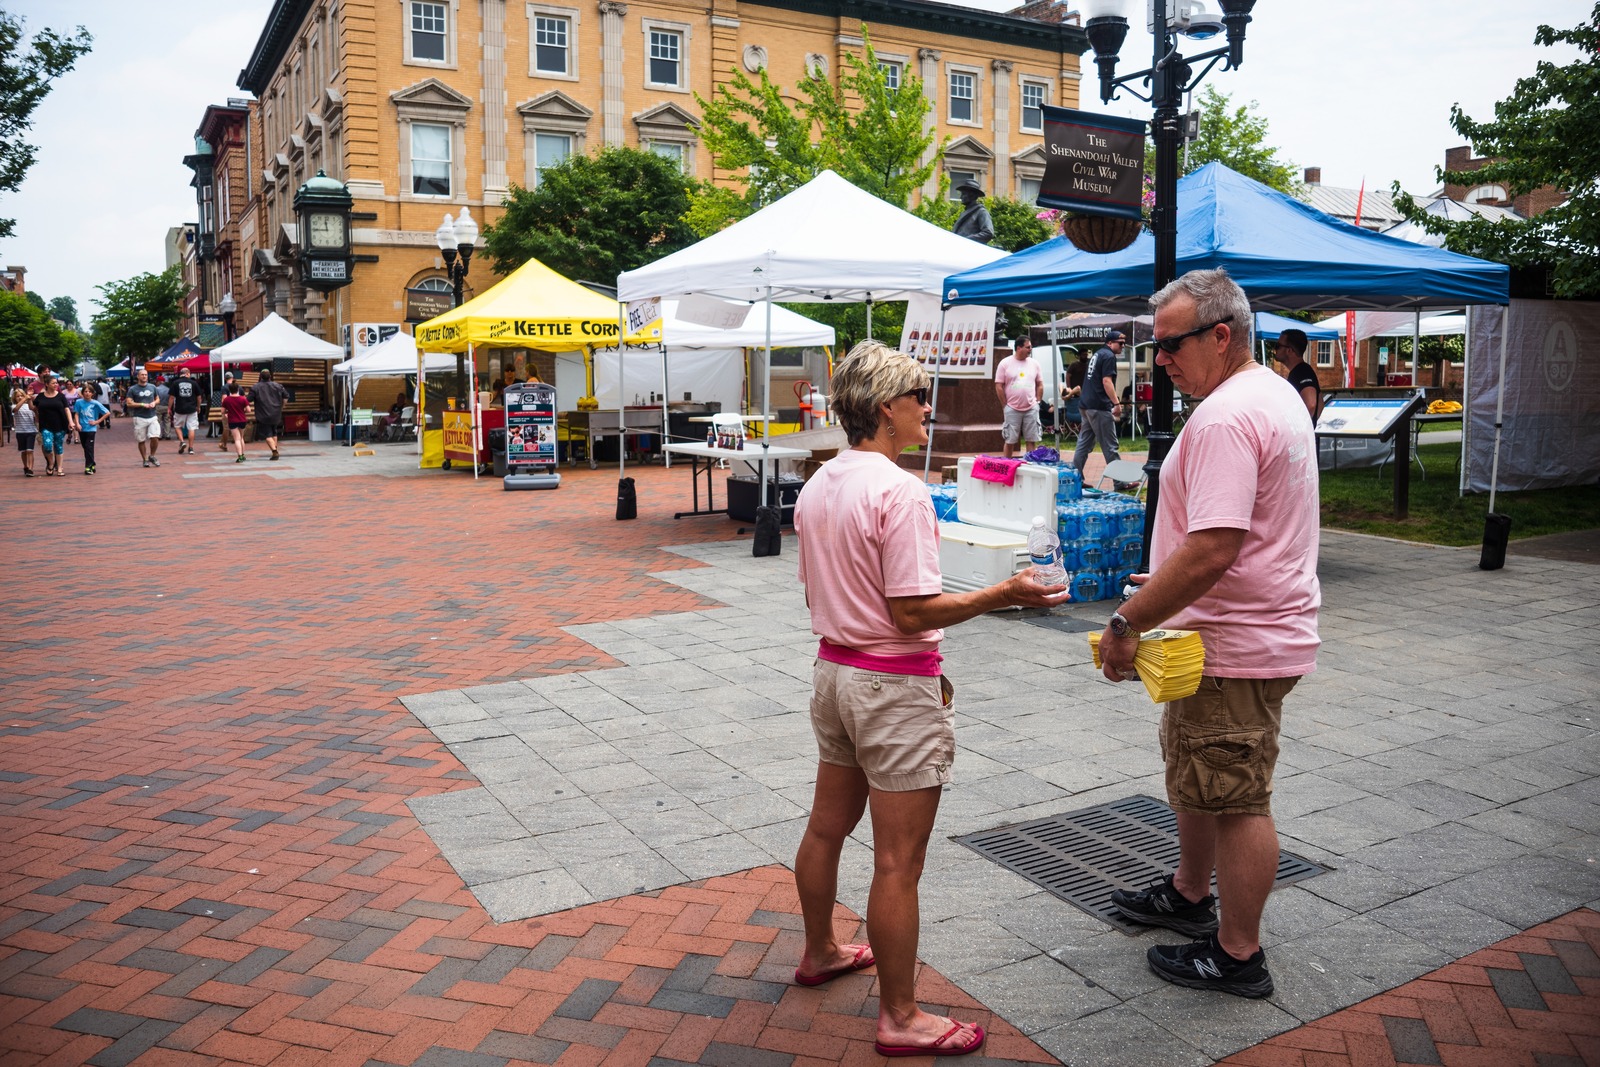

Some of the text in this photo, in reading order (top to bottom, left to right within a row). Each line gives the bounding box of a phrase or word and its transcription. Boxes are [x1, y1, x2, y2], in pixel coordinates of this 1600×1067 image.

[1086, 134, 1107, 148] THE
[1050, 144, 1139, 168] SHENANDOAH VALLEY
[1072, 162, 1118, 180] CIVIL WAR
[1072, 178, 1112, 194] MUSEUM
[629, 302, 657, 331] FREE Tea
[426, 328, 440, 342] KETTLE
[443, 325, 455, 340] CORN
[514, 320, 620, 336] KETTLE CORN
[1047, 328, 1078, 340] MNOCACY
[1079, 327, 1103, 338] BREWING
[445, 430, 463, 446] KETTLE
